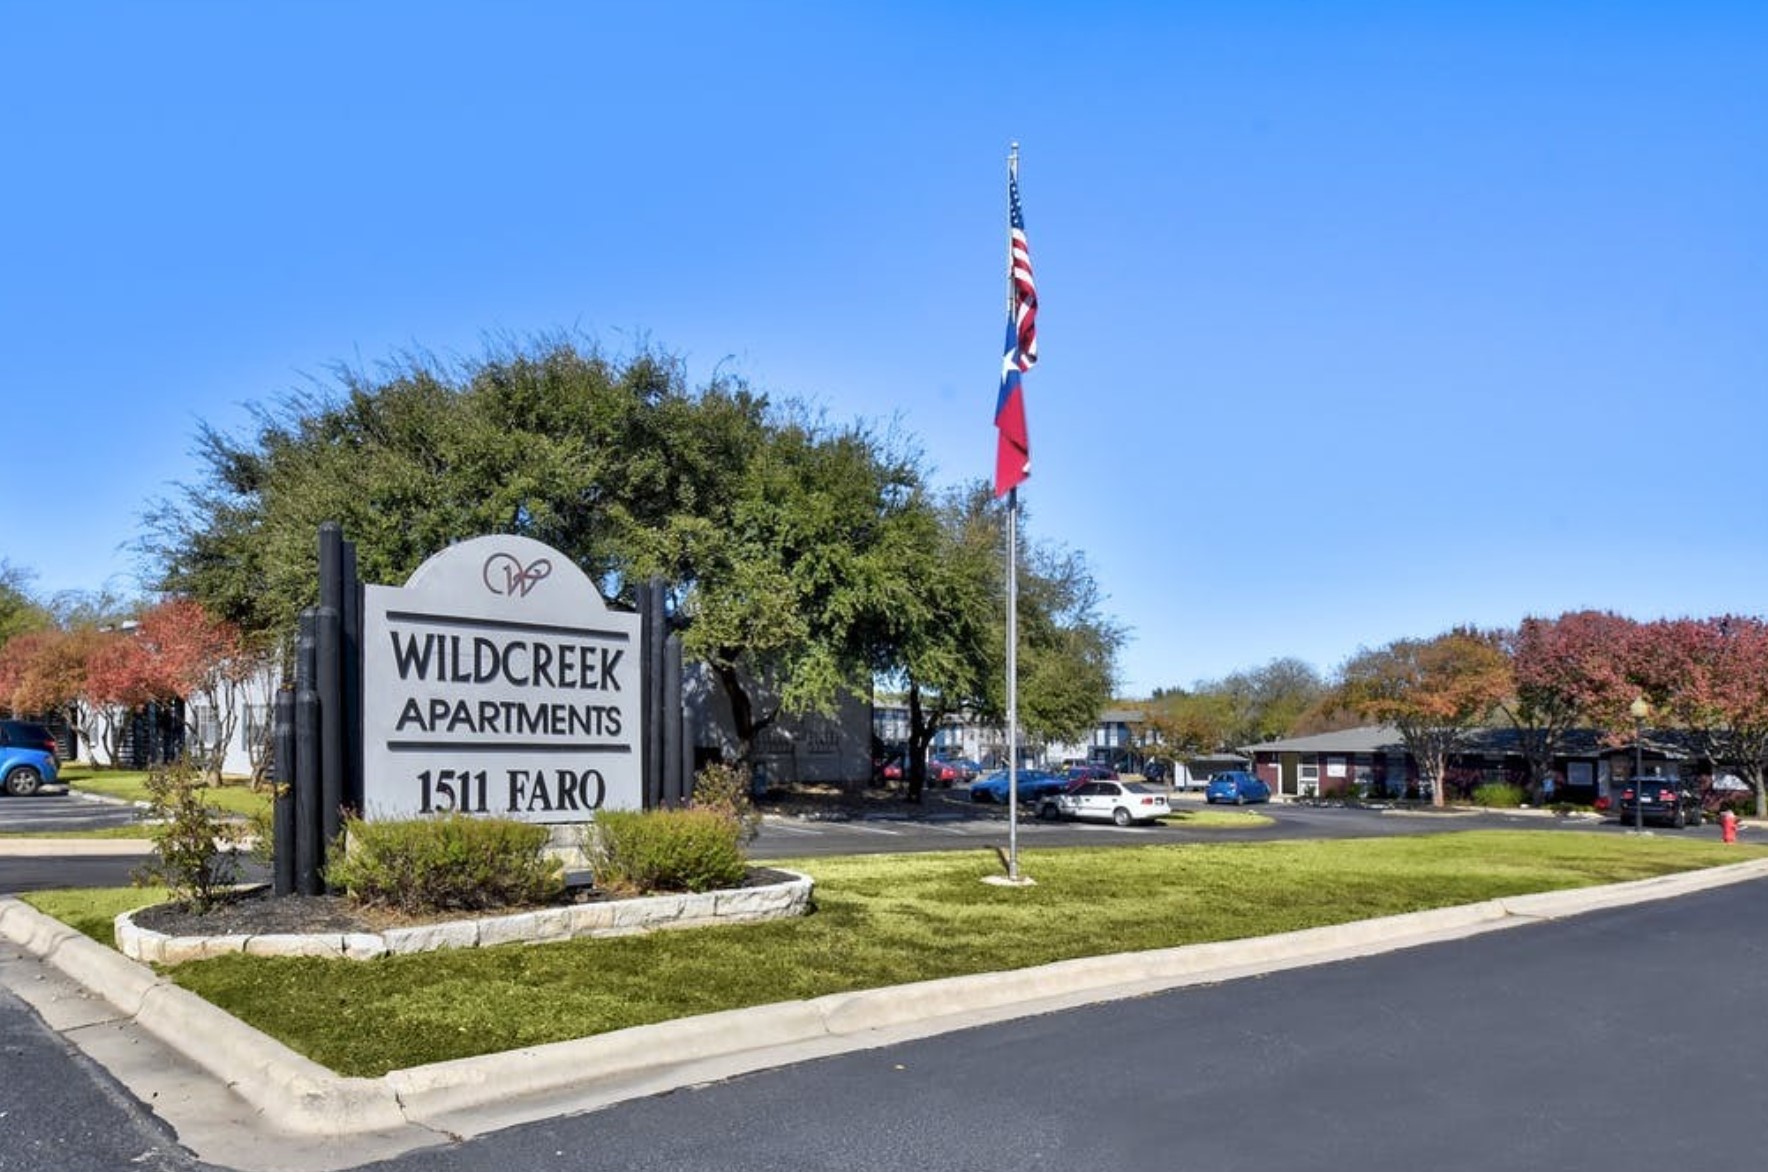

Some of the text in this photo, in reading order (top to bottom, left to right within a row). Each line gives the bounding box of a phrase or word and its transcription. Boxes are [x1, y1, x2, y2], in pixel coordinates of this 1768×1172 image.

[390, 631, 624, 691] WILDCREEK
[396, 698, 622, 737] APARTMENTS
[417, 769, 606, 814] 1511 FARO
